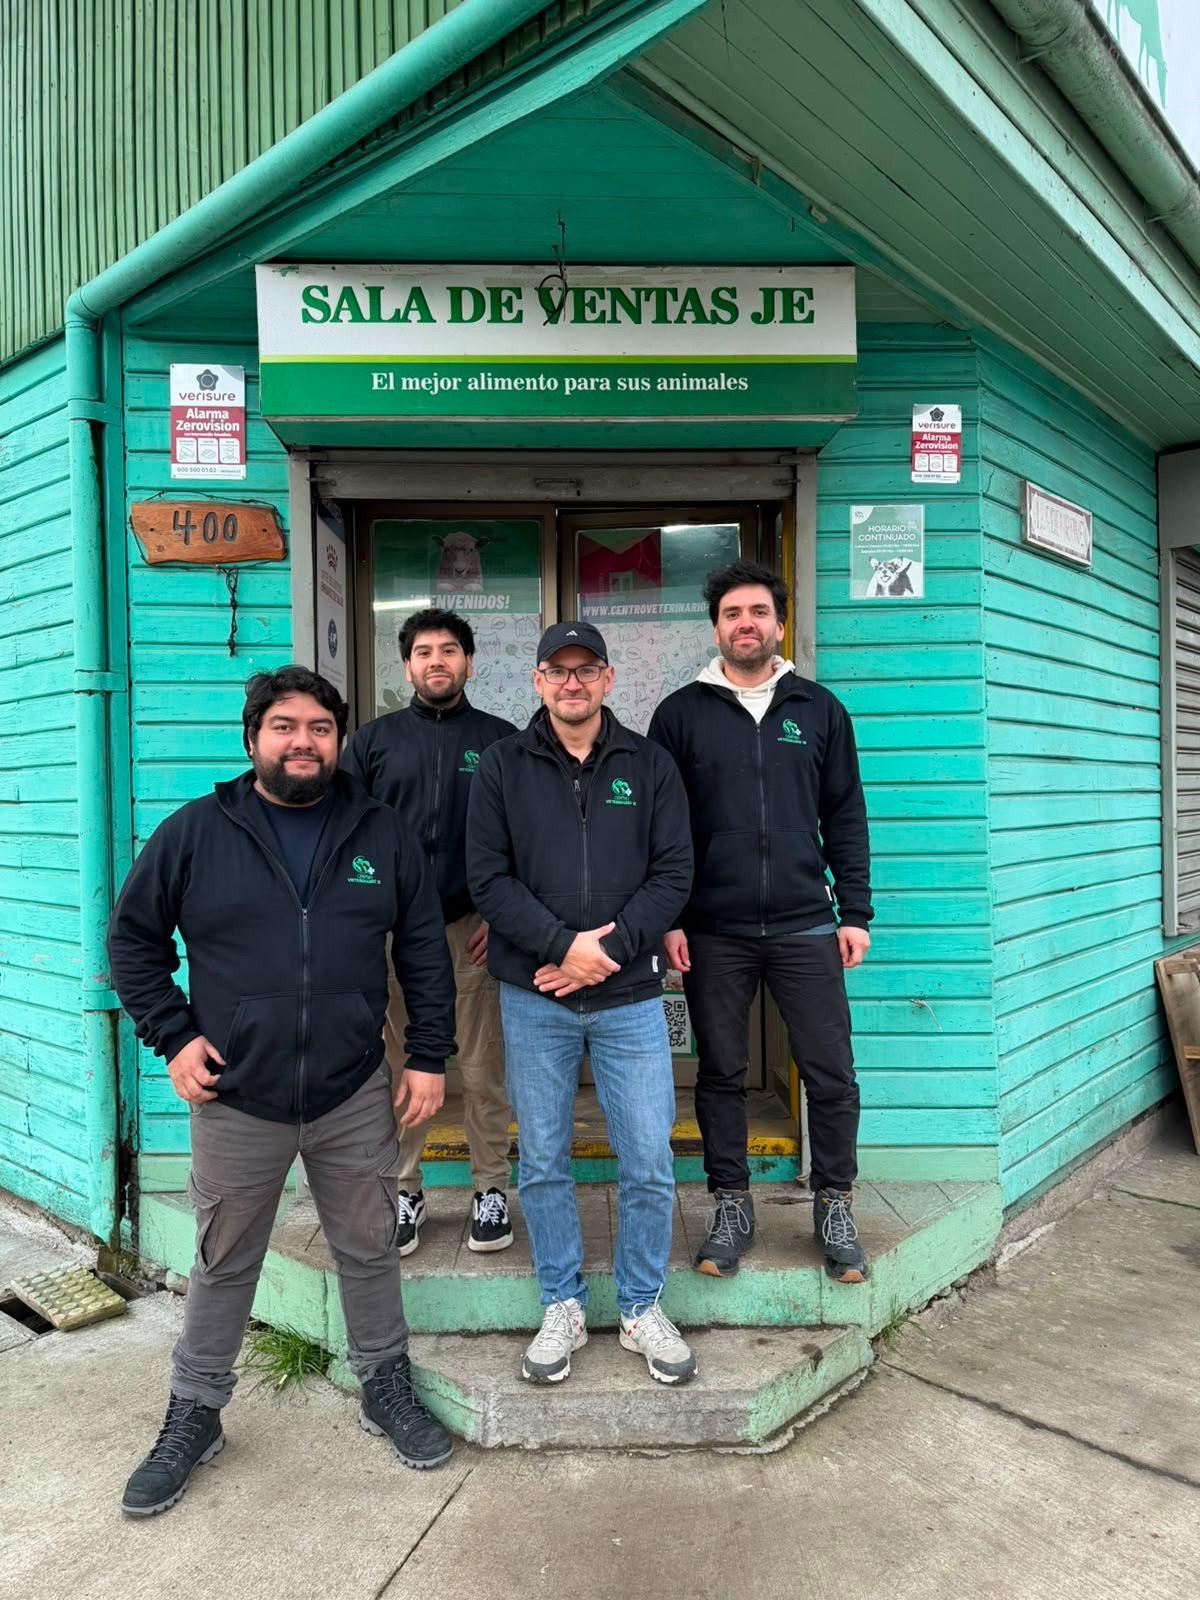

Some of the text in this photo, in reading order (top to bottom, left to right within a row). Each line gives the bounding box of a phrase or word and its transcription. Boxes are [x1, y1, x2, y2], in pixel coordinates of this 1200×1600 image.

[302, 285, 814, 325] SALA DE VENTAS JE
[372, 372, 748, 395] El mejor alimento para sus animales
[179, 392, 236, 401] verisure
[186, 408, 229, 419] Alarma
[176, 419, 240, 432] Zerovision
[922, 433, 952, 442] Alarma
[915, 440, 959, 450] Zerovision
[172, 510, 239, 546] 400
[858, 533, 916, 541] CONTINUADO
[411, 594, 510, 610] ENVENIDOS!
